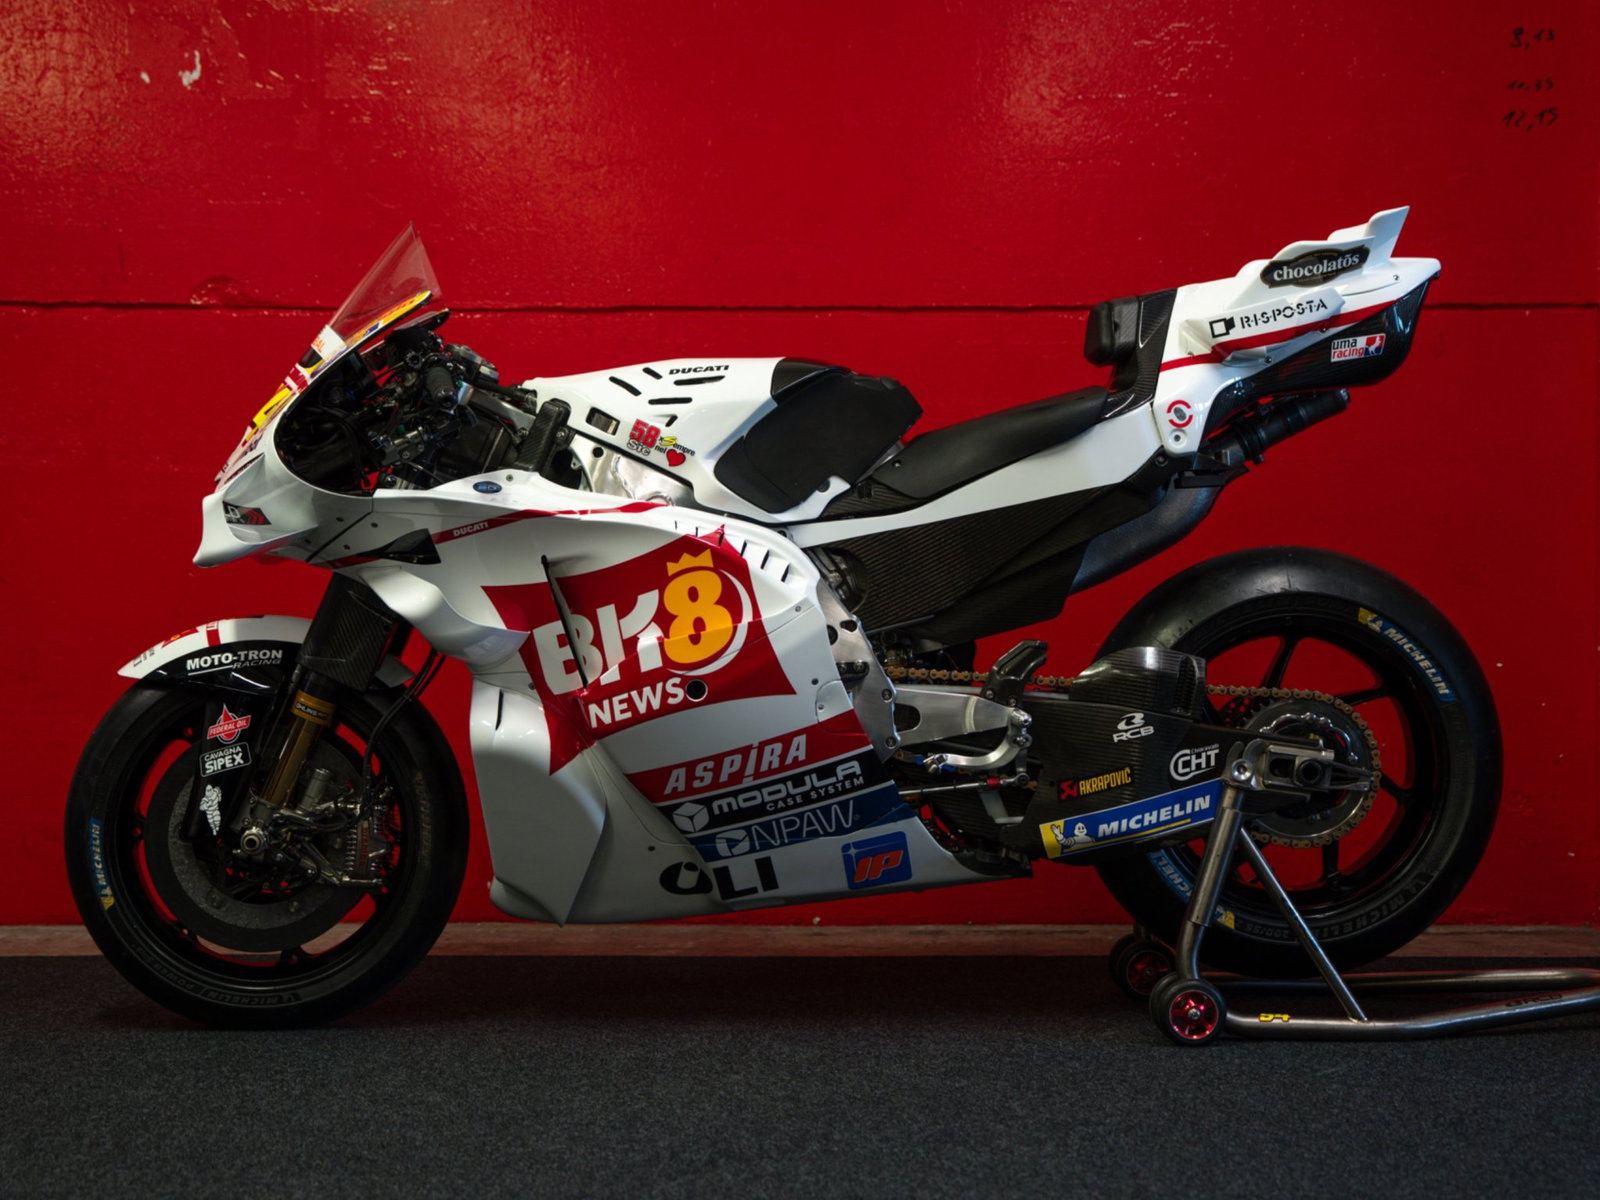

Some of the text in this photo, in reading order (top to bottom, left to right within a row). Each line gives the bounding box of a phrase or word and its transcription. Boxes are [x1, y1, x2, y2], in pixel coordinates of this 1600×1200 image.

[1332, 337, 1357, 349] uma
[1332, 347, 1365, 359] racing
[669, 365, 729, 375] DUCATI
[630, 418, 661, 448] 58
[453, 522, 489, 537] DUCATI
[232, 658, 281, 670] RACING
[1384, 627, 1450, 695] MICHELIN
[588, 677, 685, 728] NEWS
[209, 718, 248, 736] FEDERAL OIL
[1113, 726, 1155, 742] RCB
[204, 746, 242, 761] CAVAGNA
[205, 752, 244, 774] SIPEX
[1178, 749, 1219, 774] CHT
[766, 776, 865, 812] CASE SYSTEM
[751, 800, 854, 850] NPAW
[1098, 795, 1211, 837] MICHELIN
